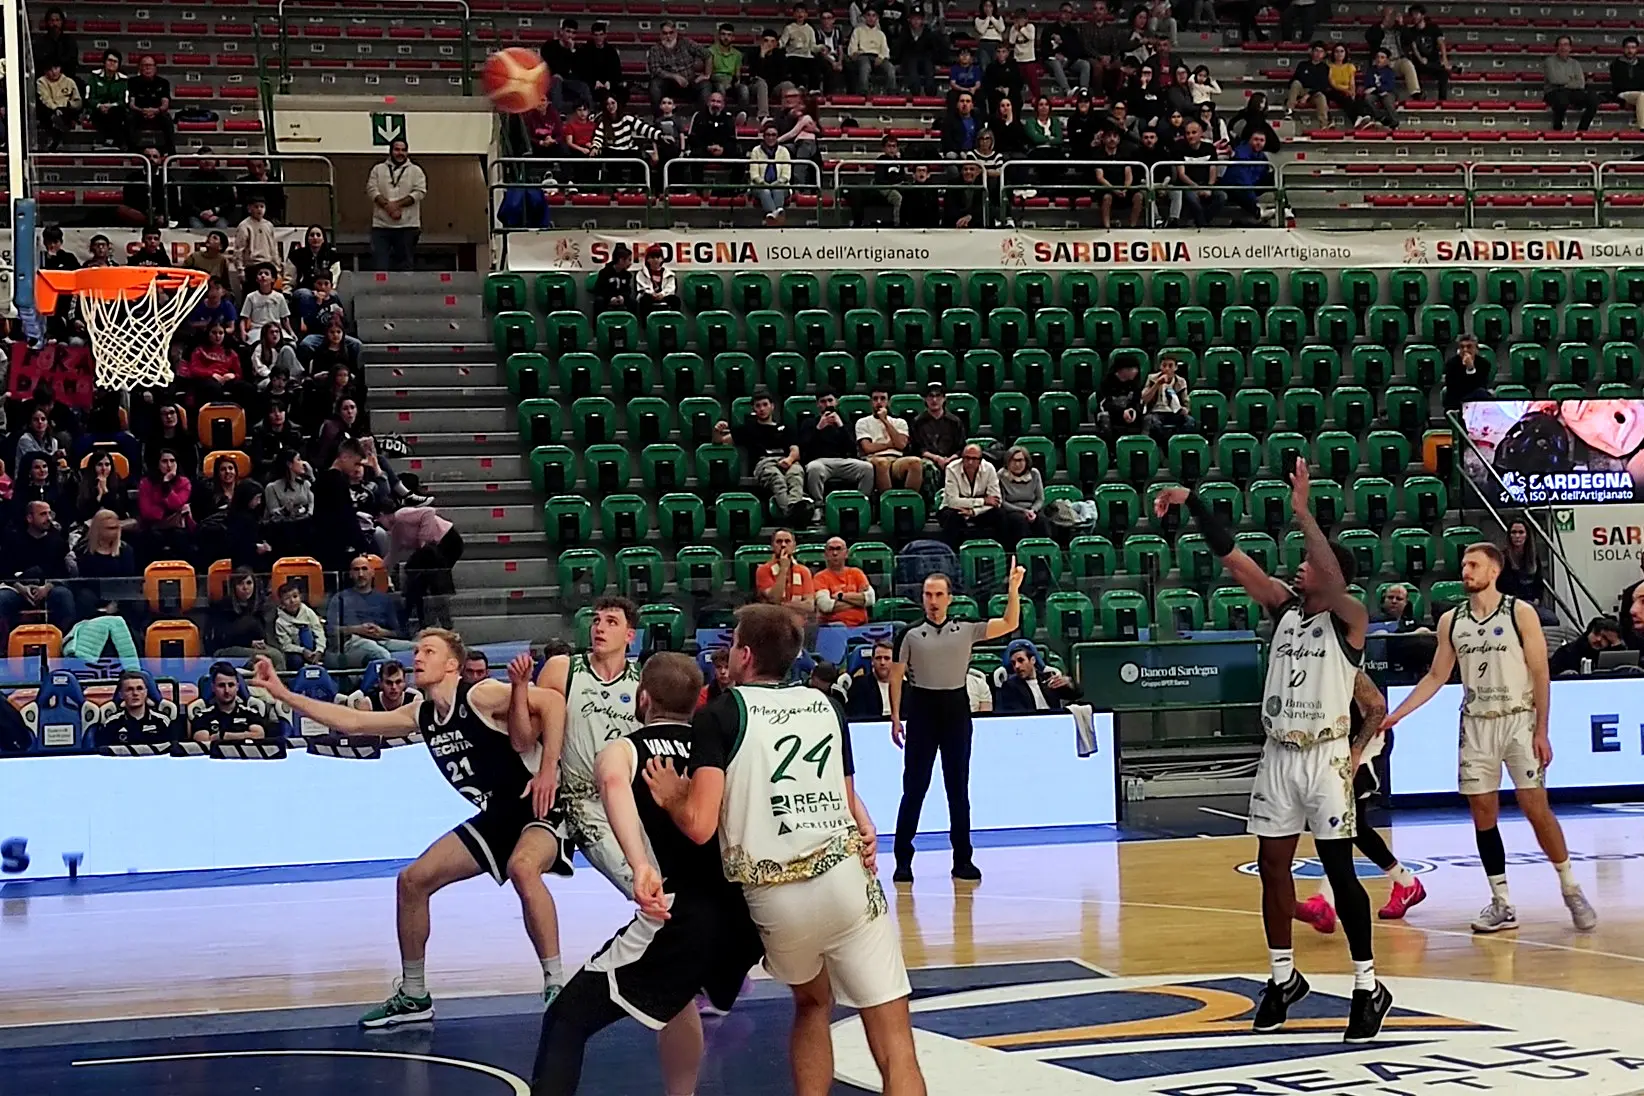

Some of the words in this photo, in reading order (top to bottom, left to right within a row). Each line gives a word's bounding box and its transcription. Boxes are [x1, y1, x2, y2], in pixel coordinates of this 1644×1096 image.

[766, 246, 812, 259] ISOLA
[816, 246, 930, 262] dell'Artigianato
[1034, 242, 1191, 262] SARDEGNA
[1198, 246, 1242, 259] ISOLA
[1245, 245, 1351, 261] dell'Artigianato
[1436, 240, 1584, 261] SARDEGNA
[1591, 245, 1632, 257] ISOLA
[1529, 491, 1559, 501] ISOA
[1593, 549, 1632, 561] ISOLA
[1140, 667, 1168, 678] Banco
[1168, 667, 1177, 677] di
[1177, 665, 1219, 677] Sardegna
[1478, 661, 1489, 678] 9
[643, 738, 677, 756] VAN
[673, 739, 692, 759] SL
[770, 733, 833, 784] 24
[446, 756, 475, 783] 21
[794, 790, 842, 805] REAL
[795, 802, 847, 814] MUTU
